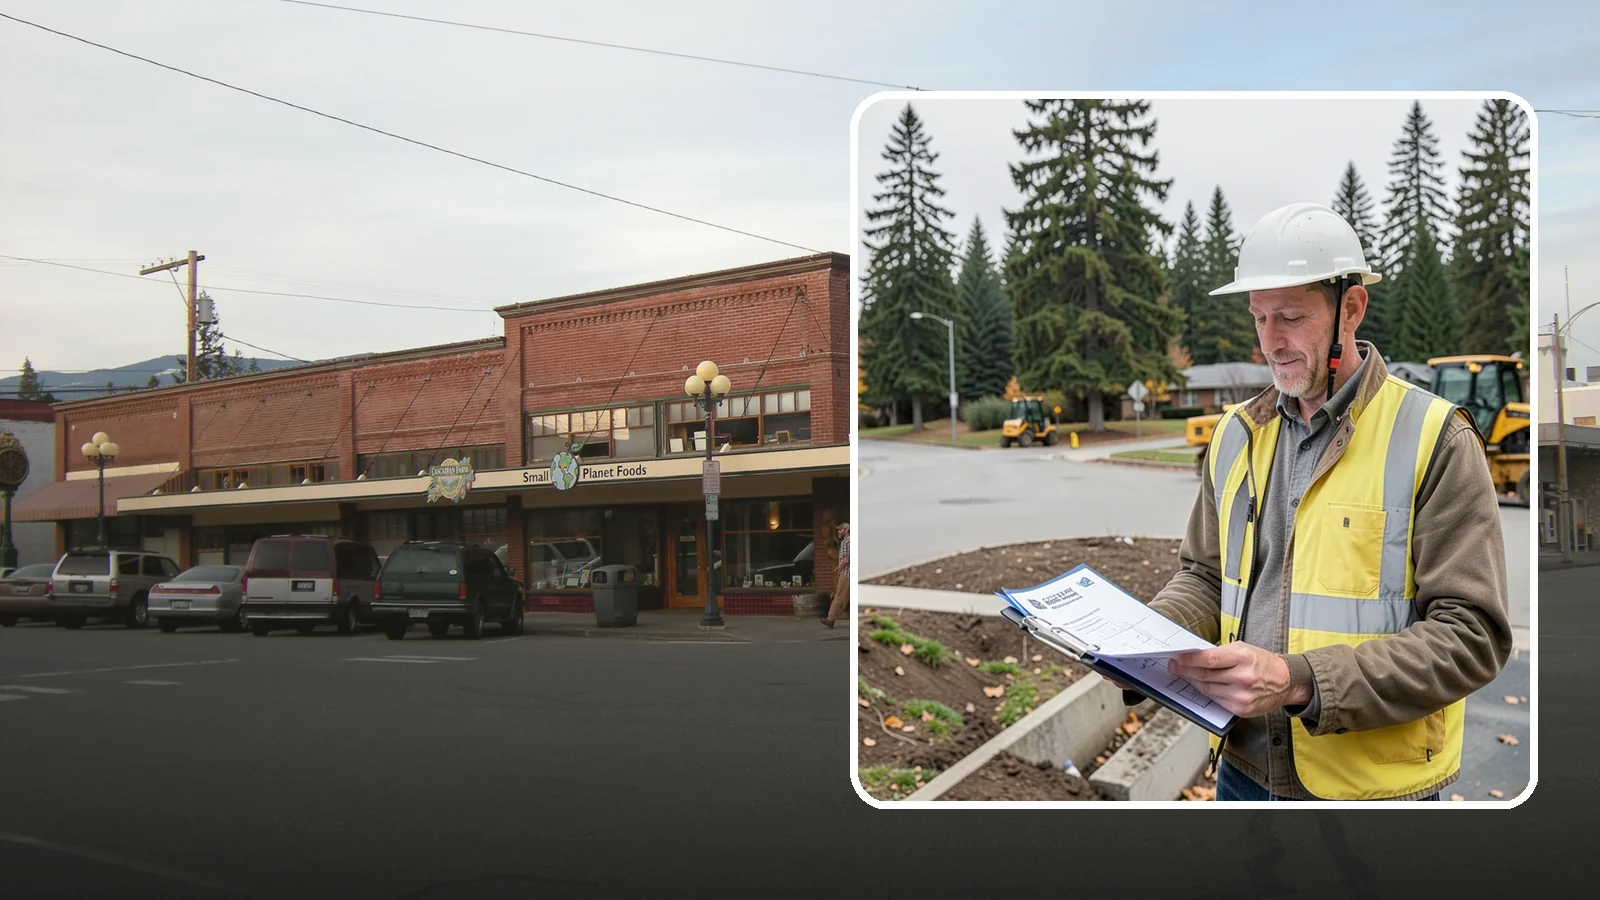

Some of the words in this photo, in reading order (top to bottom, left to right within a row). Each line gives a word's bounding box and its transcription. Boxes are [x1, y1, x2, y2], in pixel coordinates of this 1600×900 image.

[523, 471, 549, 483] Small
[583, 467, 614, 479] Planet
[617, 464, 647, 477] Foods
